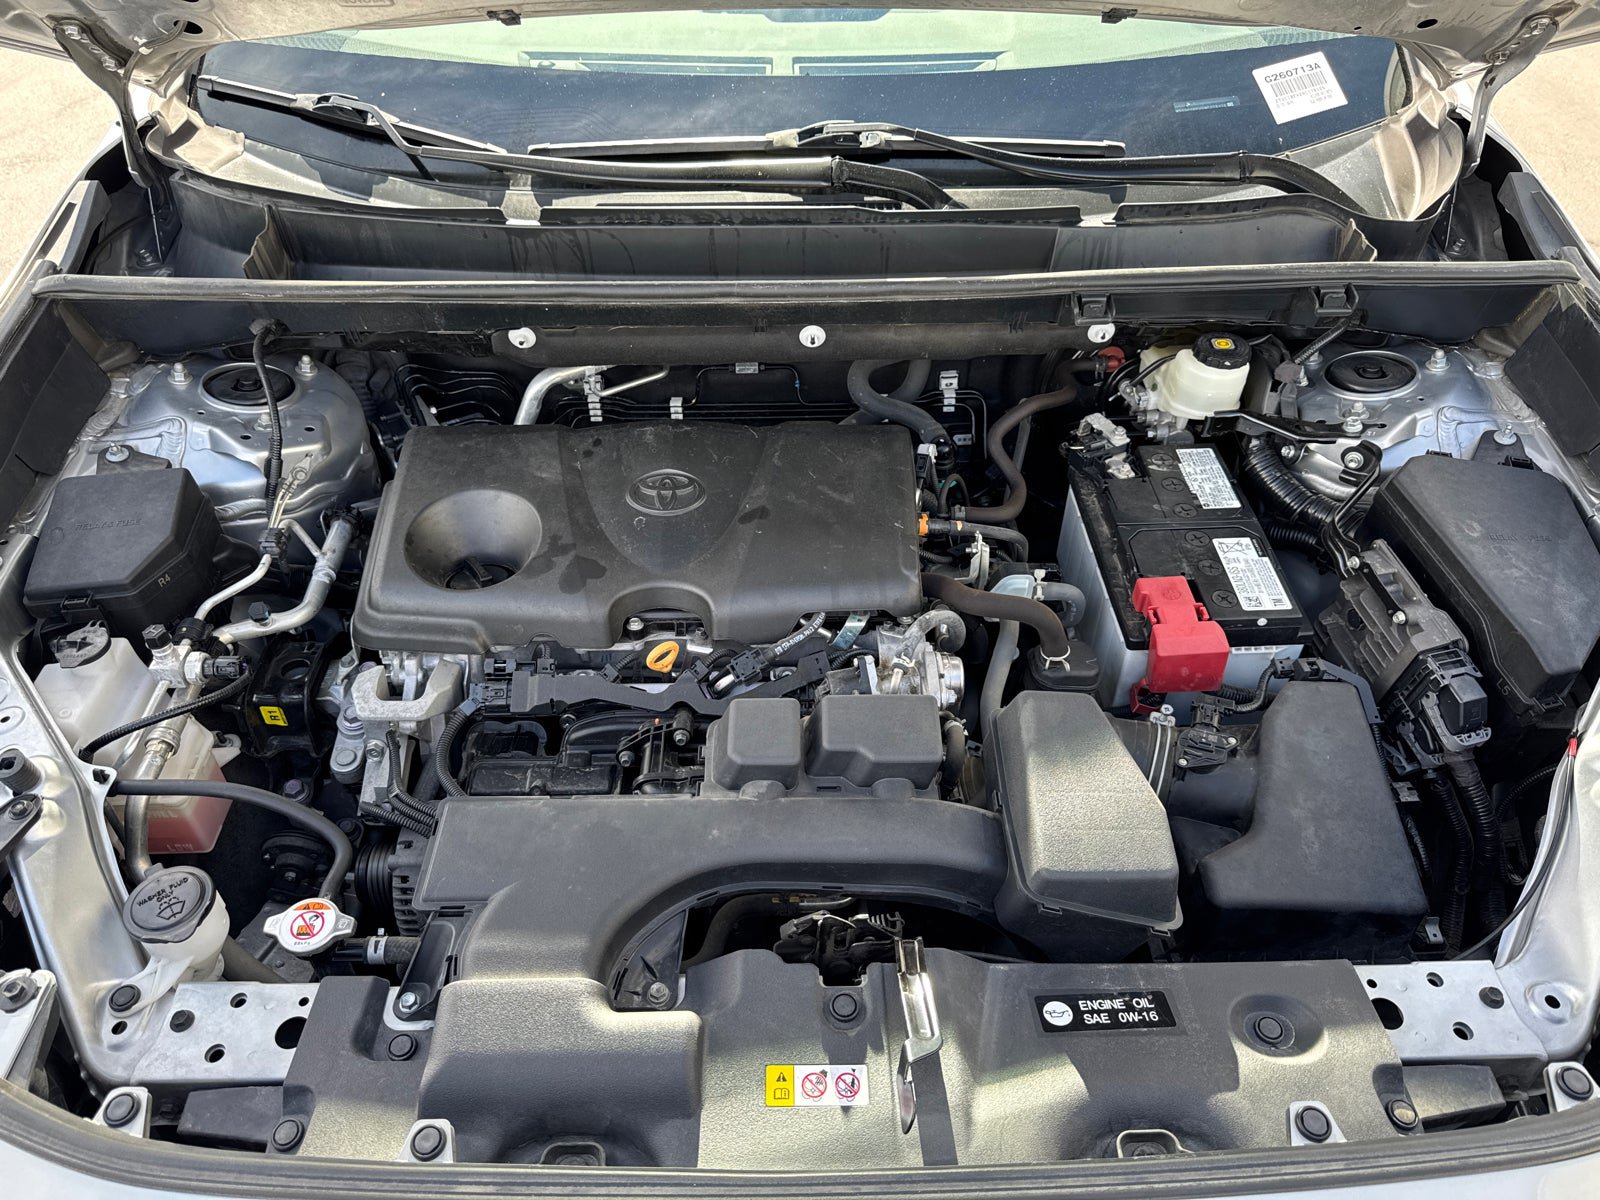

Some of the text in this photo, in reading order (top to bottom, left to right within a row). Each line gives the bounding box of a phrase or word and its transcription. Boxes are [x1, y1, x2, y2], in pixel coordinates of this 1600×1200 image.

[157, 573, 171, 588] R4
[145, 625, 163, 637] H
[1496, 677, 1511, 696] L5
[136, 877, 189, 907] WASHER FLUID
[156, 890, 175, 903] ONLY
[1078, 997, 1154, 1011] ENGINE OIL
[1083, 1010, 1159, 1025] SAE 0W-16
